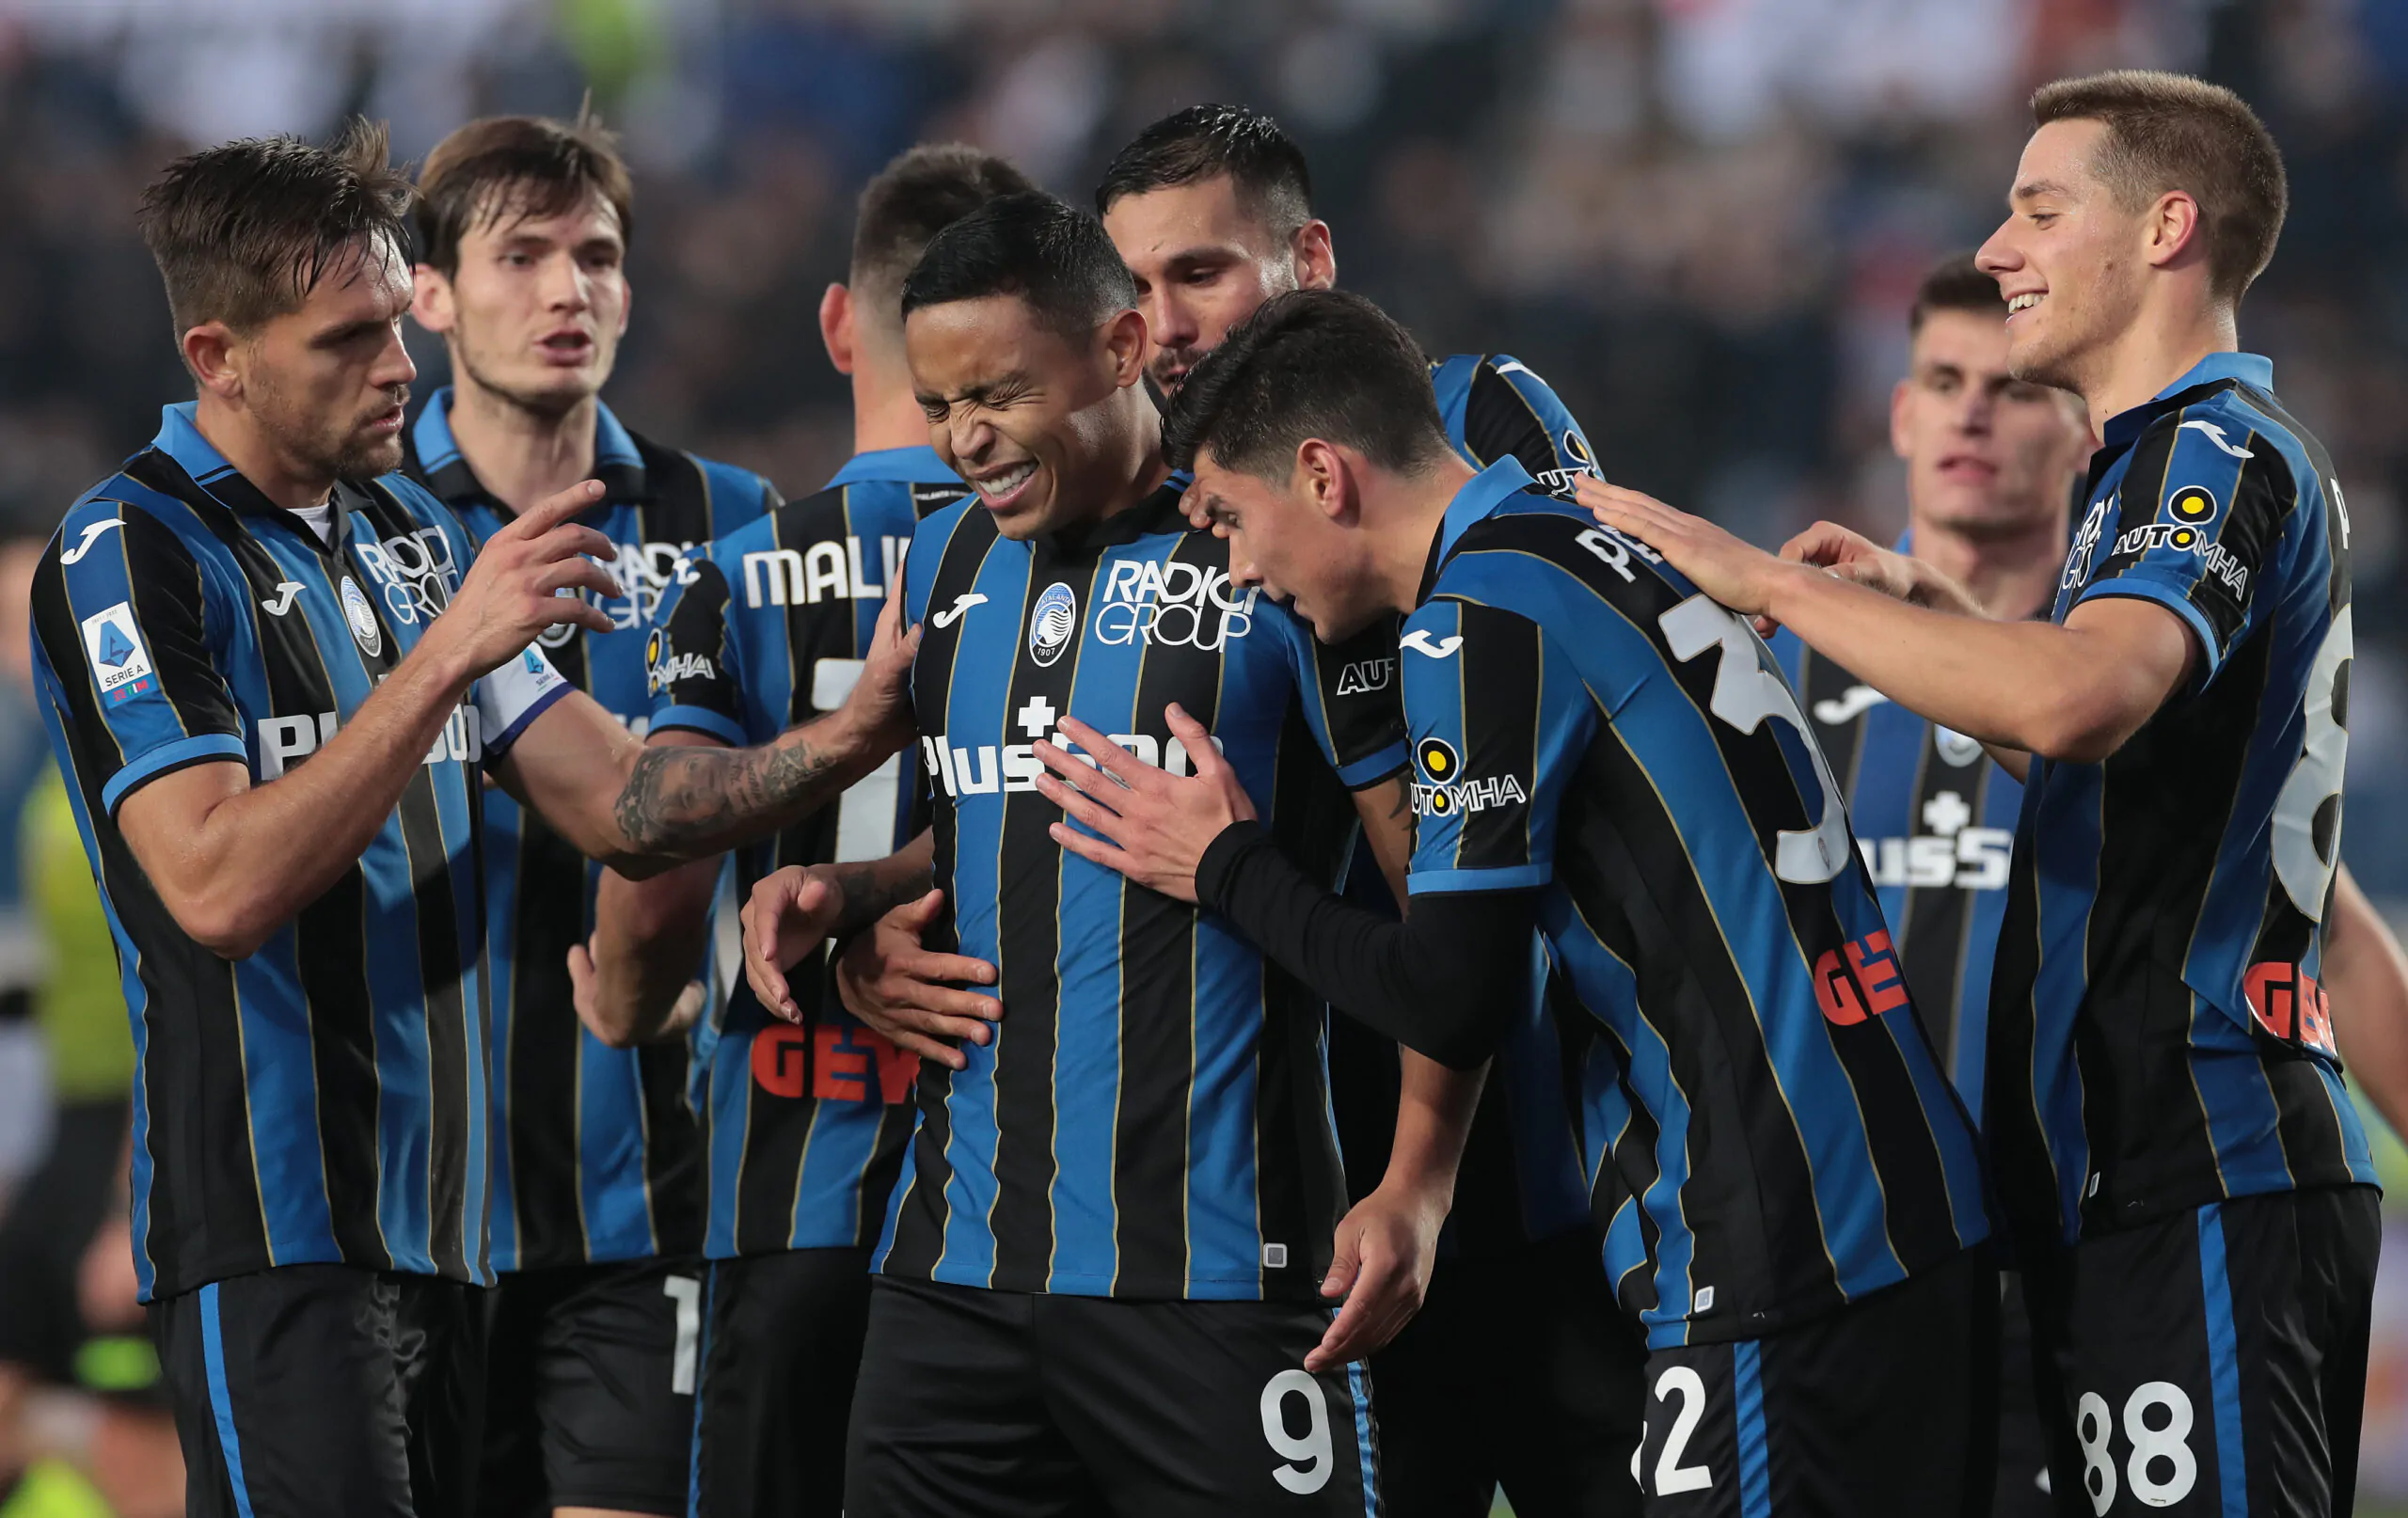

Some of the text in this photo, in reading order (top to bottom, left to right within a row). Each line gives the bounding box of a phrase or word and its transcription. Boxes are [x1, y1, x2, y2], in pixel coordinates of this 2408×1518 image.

[743, 536, 911, 609] MALI
[2112, 523, 2248, 602] AUTOMHA
[1038, 647, 1055, 656] 1907
[1095, 602, 1251, 653] GROUP
[104, 664, 145, 687] SERIE A
[125, 679, 149, 696] TIM
[1337, 657, 1395, 696] AU
[1260, 1368, 1333, 1494] 9
[2076, 1381, 2197, 1517] 88
